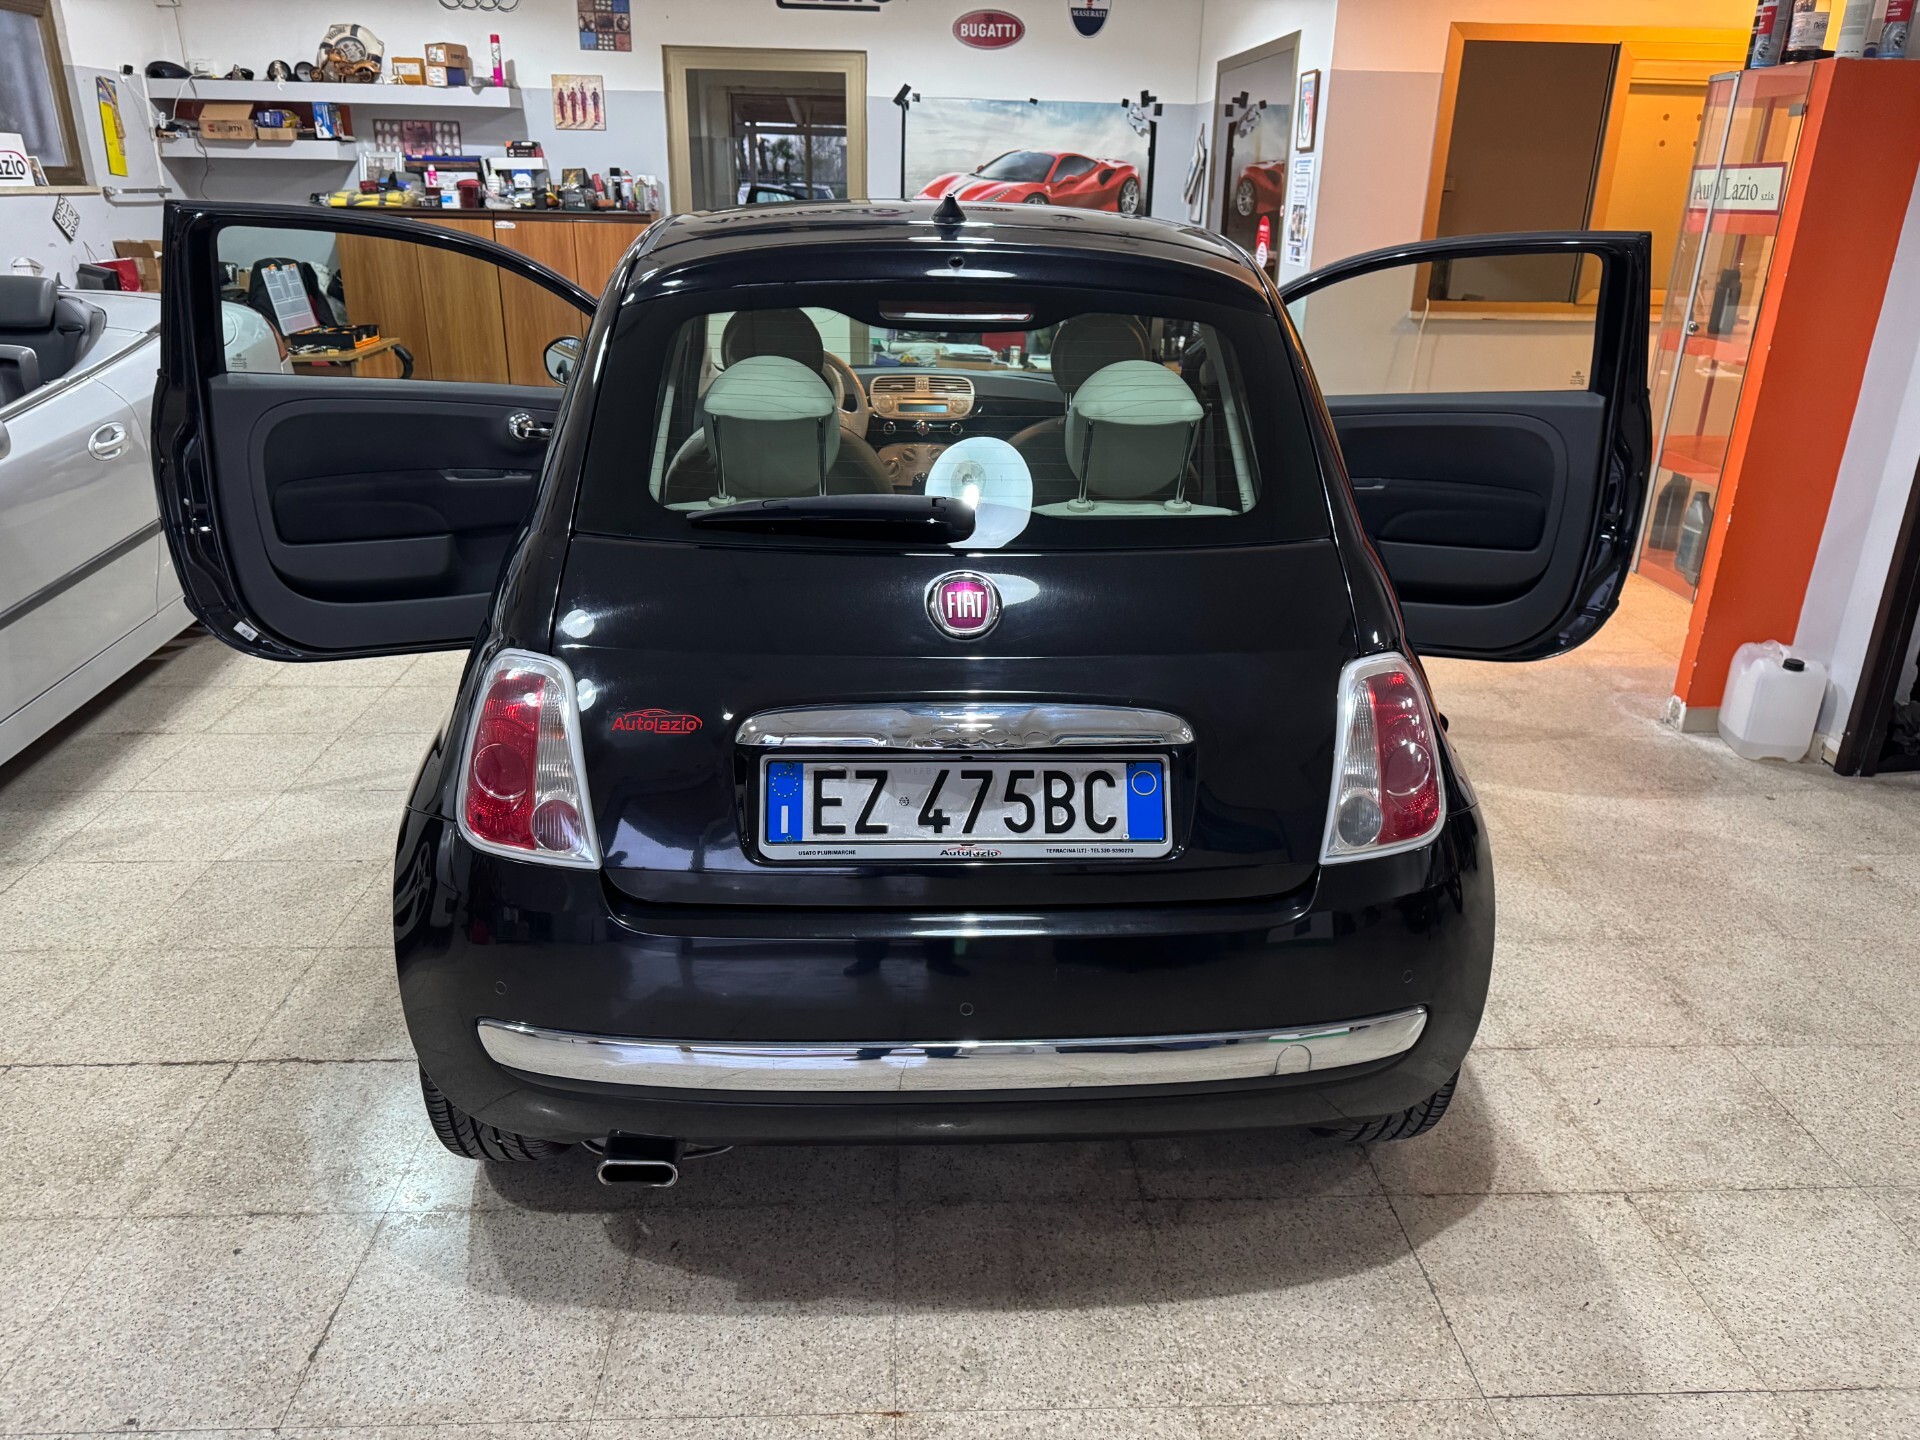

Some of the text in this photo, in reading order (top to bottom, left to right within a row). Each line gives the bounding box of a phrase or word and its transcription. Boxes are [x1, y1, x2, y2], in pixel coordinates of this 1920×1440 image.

[1072, 9, 1107, 18] MASERATI
[960, 23, 1016, 38] BUGATTI
[1723, 176, 1758, 201] Lazio
[946, 591, 985, 619] FIAT
[812, 768, 1118, 835] EZ 475BC
